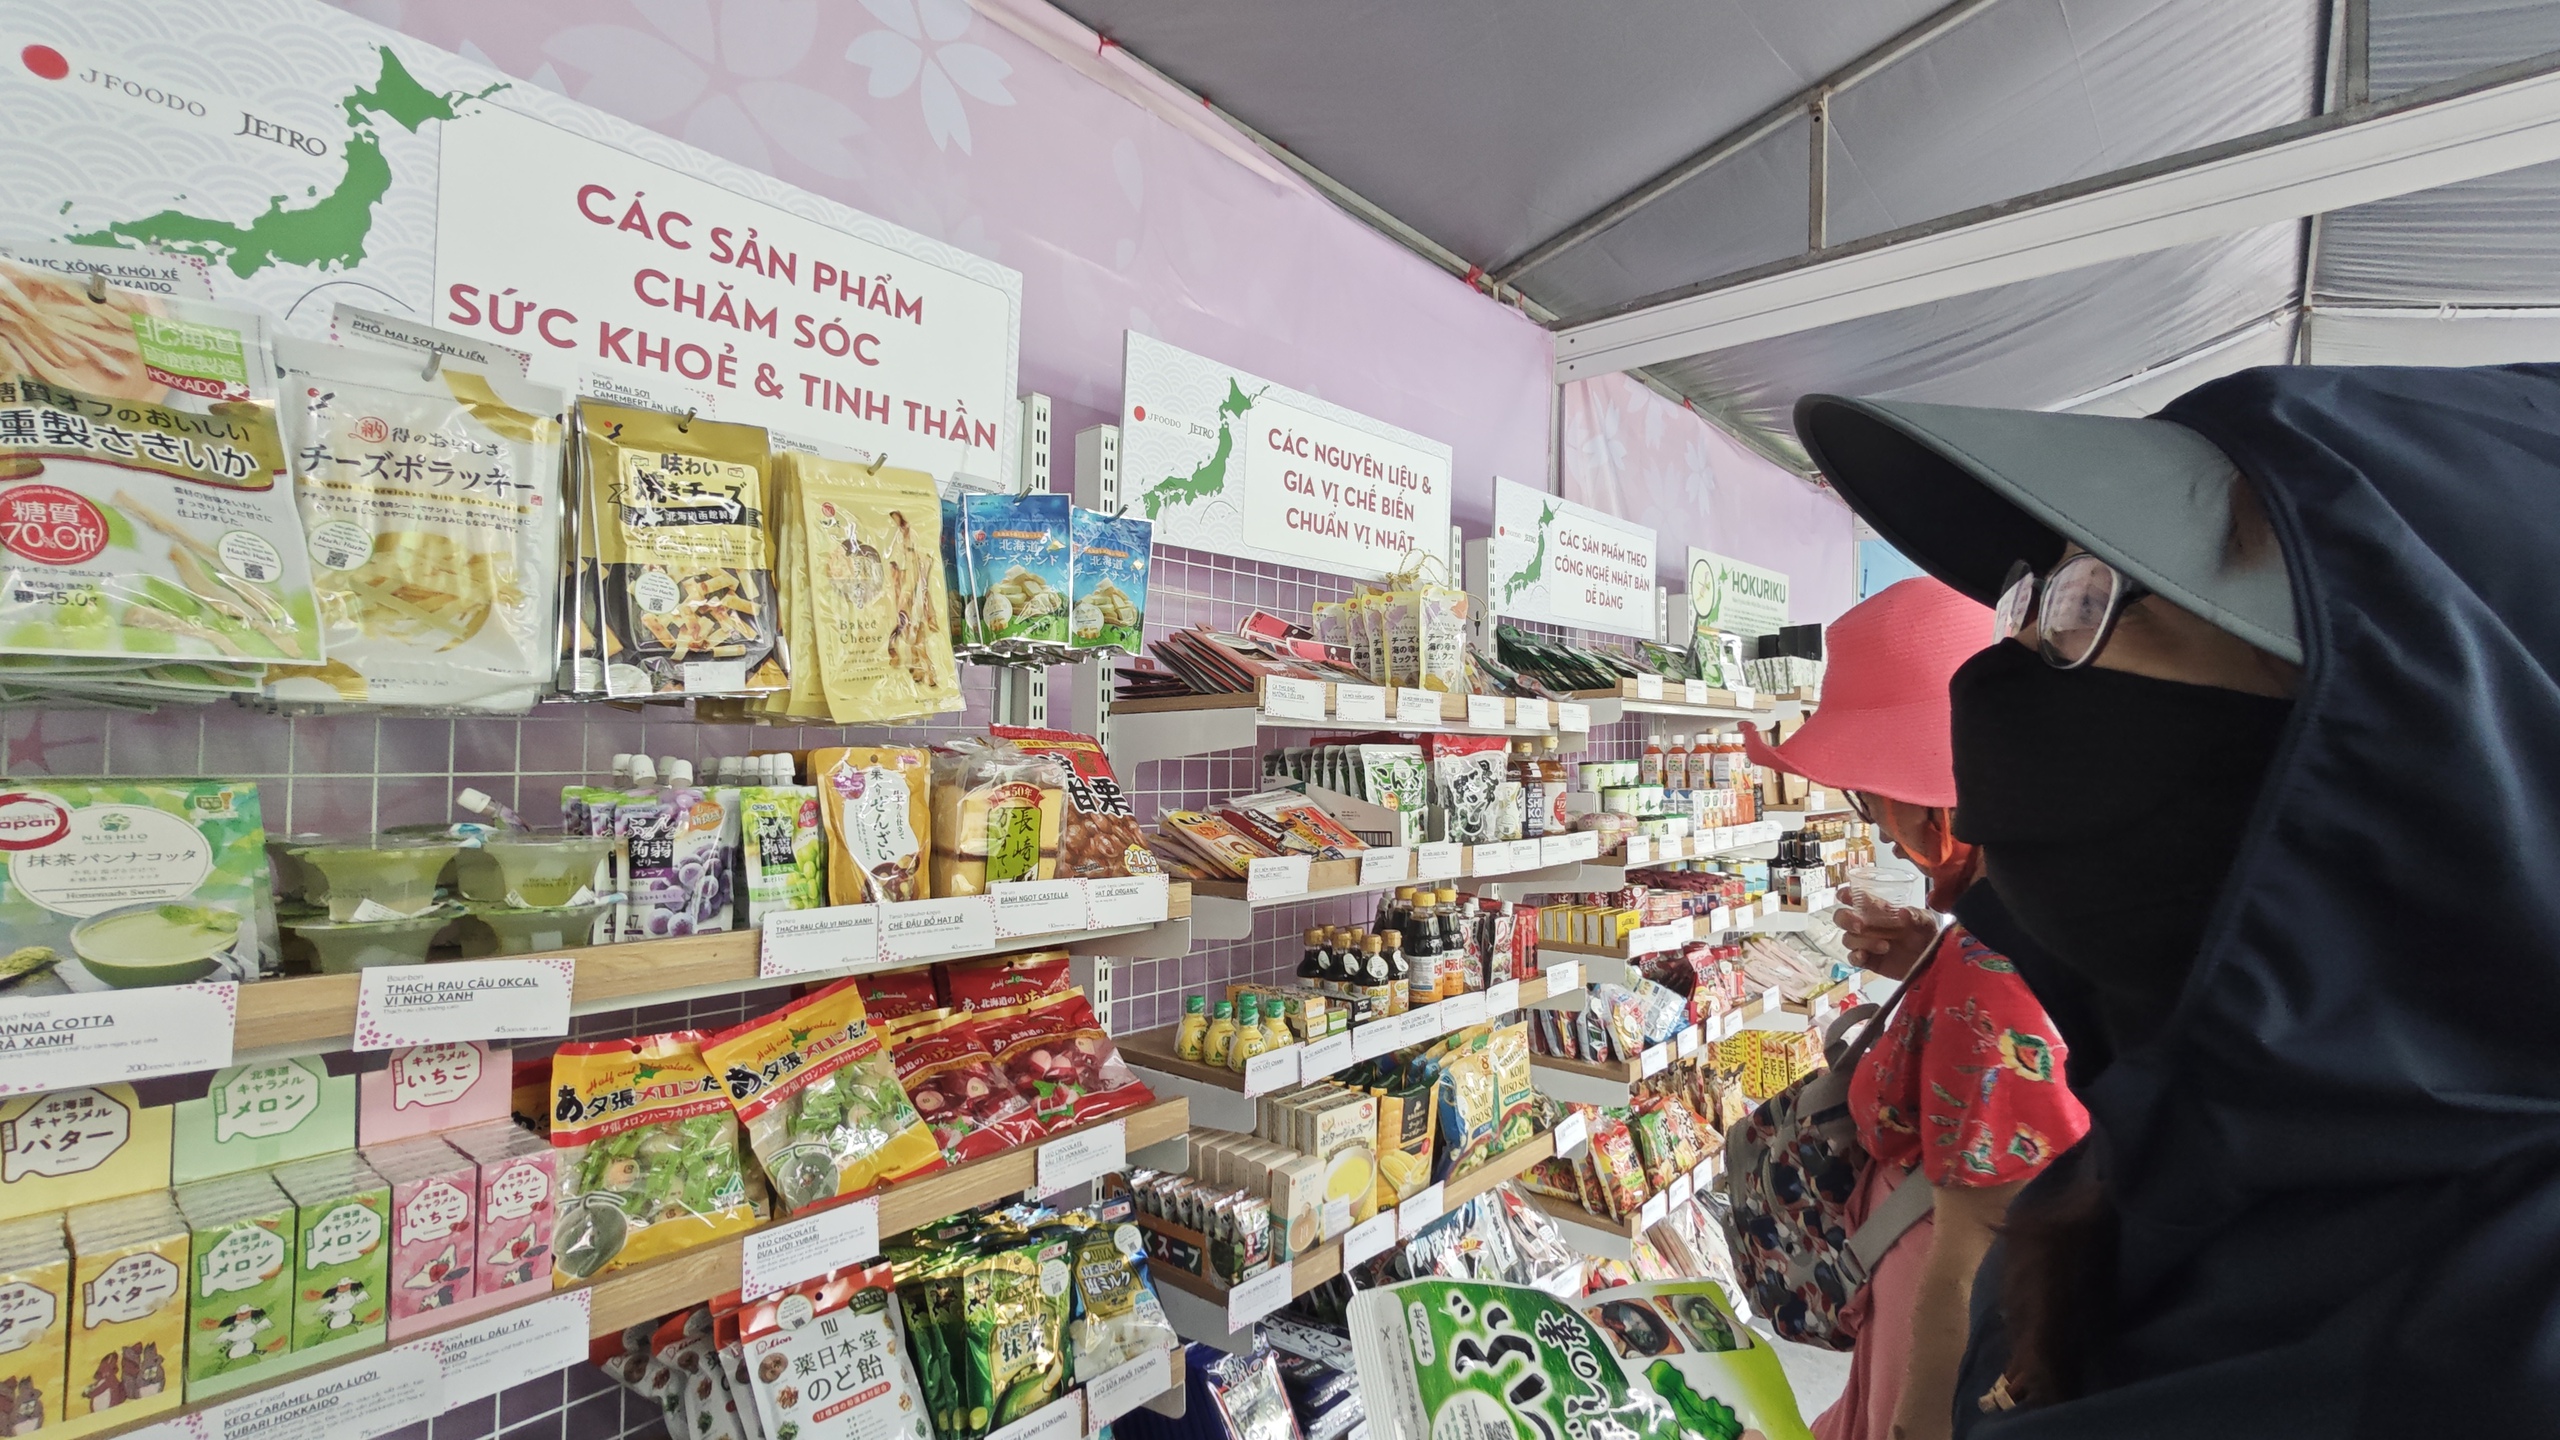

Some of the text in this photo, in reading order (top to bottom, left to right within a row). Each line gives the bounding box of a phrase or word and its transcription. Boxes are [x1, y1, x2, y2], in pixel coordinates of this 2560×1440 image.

[79, 68, 328, 158] JFOODO JETRO
[576, 184, 924, 325] CÁC SẢN PHẨM
[633, 268, 881, 367] CHĂM SÓC
[448, 283, 579, 350] SỨC
[599, 321, 738, 389] KHOẺ
[753, 362, 785, 400] &
[799, 372, 891, 426] TINH
[903, 399, 997, 452] THẦN
[149, 368, 221, 396] HOKKAIDO
[1188, 422, 1215, 440] JETRO
[1268, 427, 1431, 495] CÁC NGUYÊN LIỆU &
[1283, 469, 1415, 522] GIA VỊ CHẾ BIẾN
[1286, 507, 1415, 557] CHUẨN VỊ NHẬT
[1559, 529, 1647, 568] CÁC SẢN PHẨM THEO
[1554, 554, 1650, 592] CÔNG NGHỆ NHẬT BẢN
[1732, 570, 1786, 604] HOKURIKU
[1598, 589, 1623, 610] DÀNG
[839, 619, 877, 631] Baked
[839, 632, 883, 645] Cheese
[0, 817, 56, 831] apan
[27, 849, 197, 868] 抹茶パンナコッタ
[636, 858, 660, 867] ゼリー
[1124, 849, 1157, 866] 216g
[66, 885, 167, 900] Homemade Sweets
[1038, 891, 1069, 901] CASTELLA
[854, 917, 873, 926] XANH
[386, 976, 495, 995] THẠCH RAU CÂU
[402, 994, 434, 1005] NHO
[438, 991, 474, 1003] XANH
[52, 1014, 115, 1030] COTTA
[23, 1033, 74, 1048] XANH
[412, 1049, 469, 1066] キャラメル
[250, 1066, 290, 1081] 北海道
[407, 1063, 472, 1088] いちご
[1509, 1064, 1525, 1079] KOJI
[237, 1075, 305, 1095] キャラメル
[1499, 1081, 1518, 1096] MISO
[46, 1096, 95, 1113] 北海道
[232, 1093, 306, 1119] メロン
[30, 1107, 113, 1129] キャラメル
[21, 1130, 115, 1154] バター
[499, 1175, 540, 1191] キャラメル
[507, 1169, 531, 1182] 北海道
[414, 1194, 459, 1211] キャラメル
[423, 1188, 449, 1202] 北海道
[495, 1186, 542, 1207] いちご
[322, 1215, 371, 1233] キャラメル
[332, 1209, 361, 1222] 北海道
[410, 1205, 461, 1228] いちご
[228, 1232, 261, 1247] 北海道
[317, 1230, 371, 1252] メロン
[774, 1225, 818, 1243] CHOCOLATE
[217, 1239, 273, 1257] キャラメル
[116, 1260, 152, 1275] 北海道
[213, 1253, 274, 1278] メロン
[104, 1267, 166, 1287] キャラメル
[98, 1285, 167, 1308] バター
[792, 1328, 881, 1380] 薬日本堂
[807, 1353, 885, 1402] のど飴
[255, 1392, 311, 1419] CARAMEL
[223, 1395, 339, 1440] YUBARI HOKKAIDO
